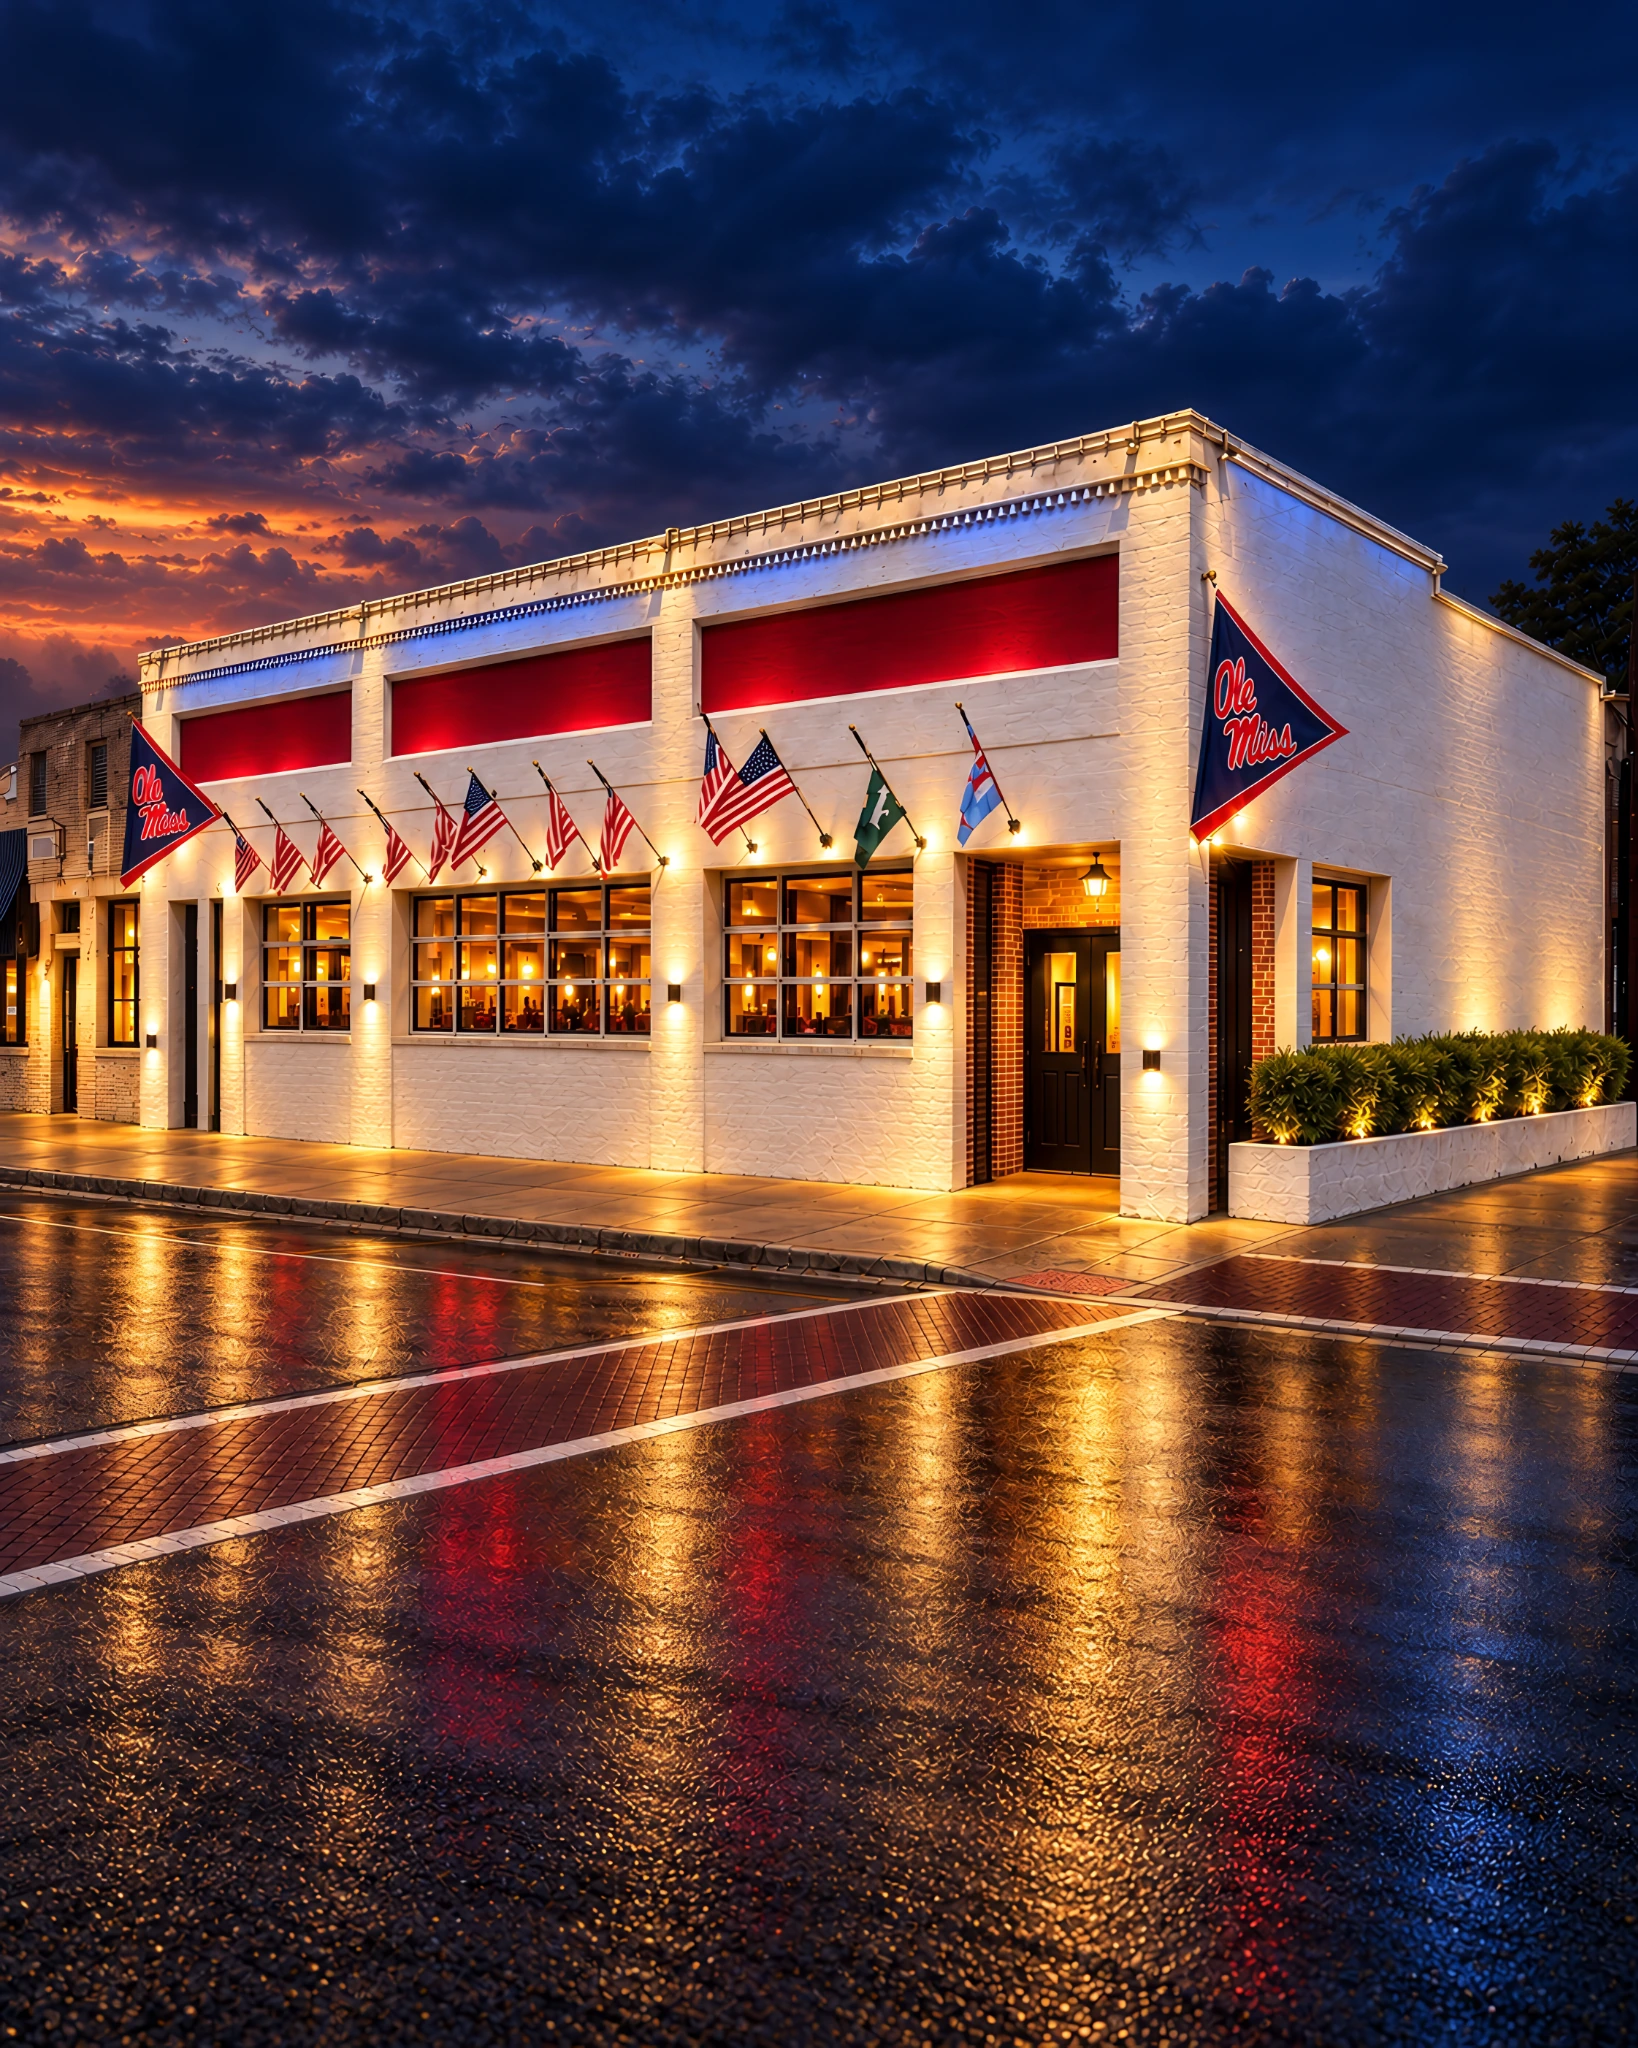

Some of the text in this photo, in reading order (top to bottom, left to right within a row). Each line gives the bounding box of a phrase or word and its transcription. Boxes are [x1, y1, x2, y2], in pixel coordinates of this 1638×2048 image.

[1214, 656, 1257, 720] Ole
[1223, 713, 1297, 771] Miss
[132, 763, 163, 806] Ole
